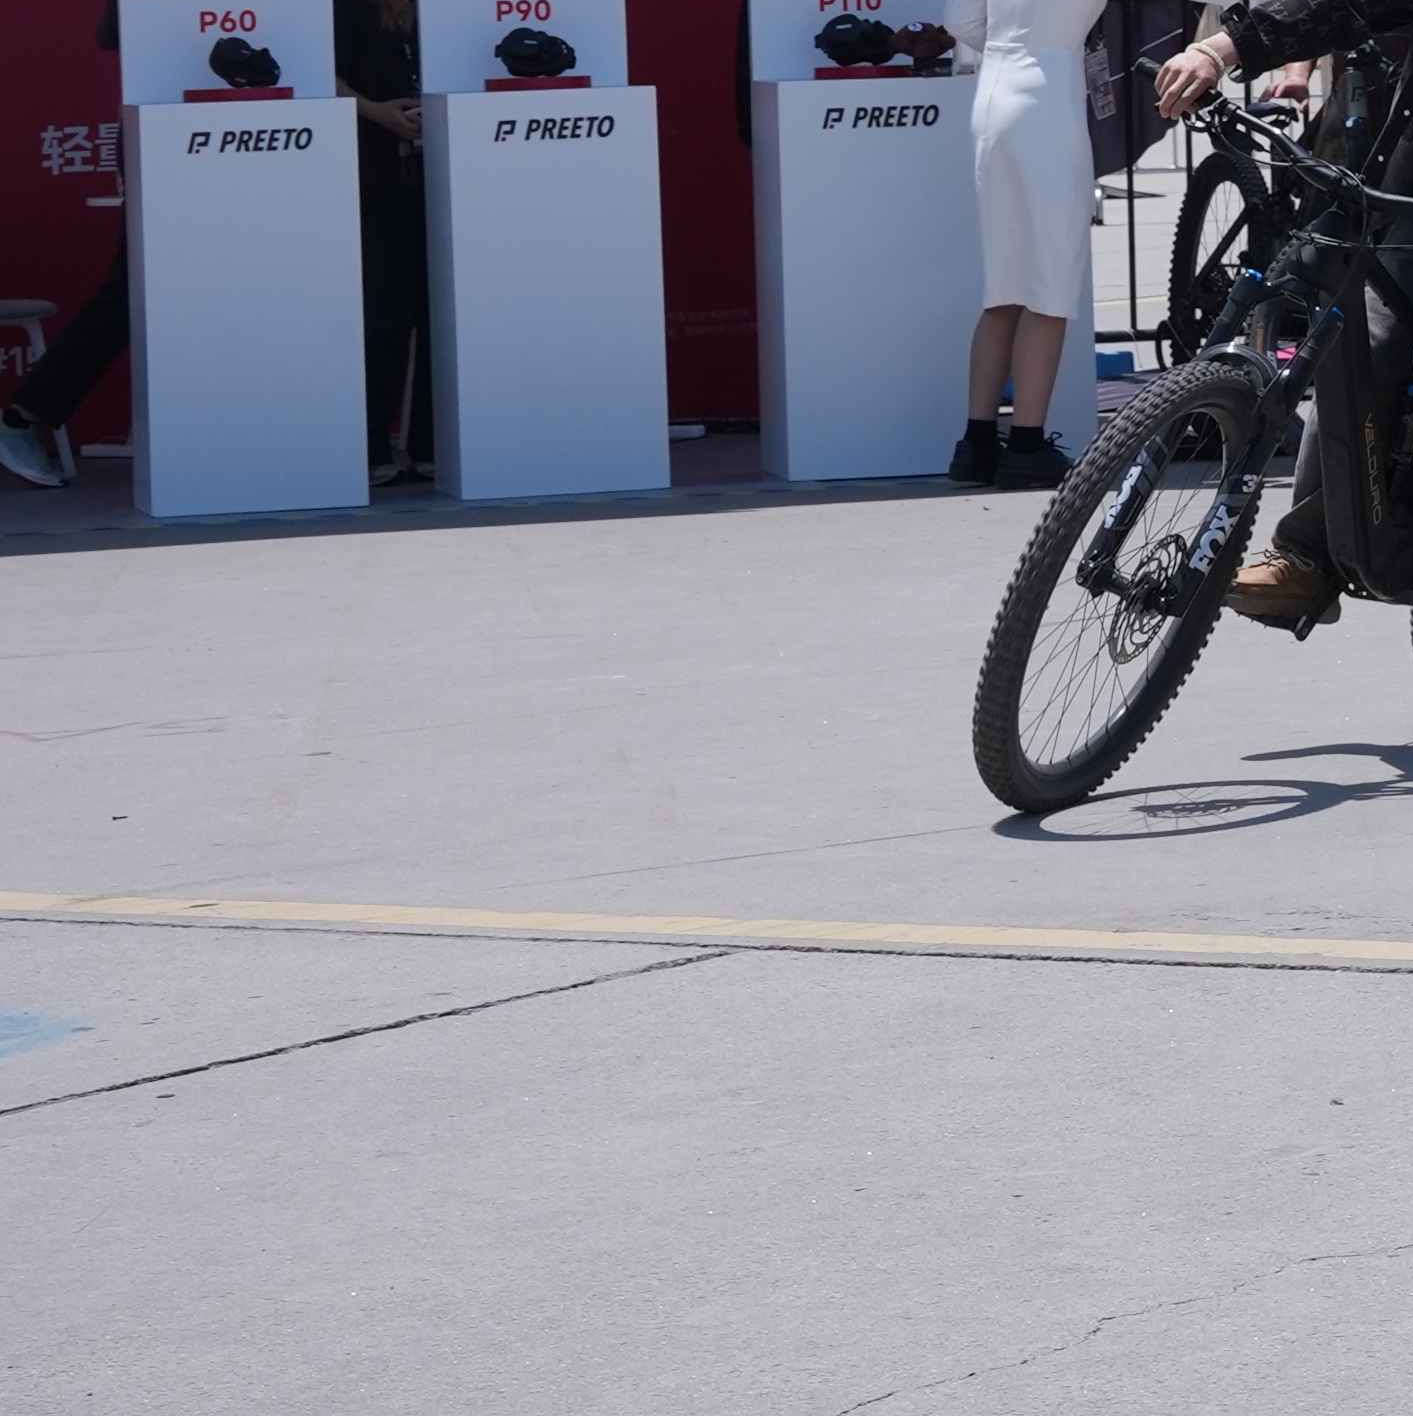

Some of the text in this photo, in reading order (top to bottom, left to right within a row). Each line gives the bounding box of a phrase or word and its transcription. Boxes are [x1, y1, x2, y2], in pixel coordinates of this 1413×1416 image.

[199, 10, 257, 33] P60
[495, 0, 552, 22] P90
[524, 115, 615, 141] PREETO
[852, 104, 940, 129] PREETO
[218, 127, 313, 153] PREETO
[1362, 412, 1383, 526] VELDURO
[1187, 504, 1243, 577] FOX
